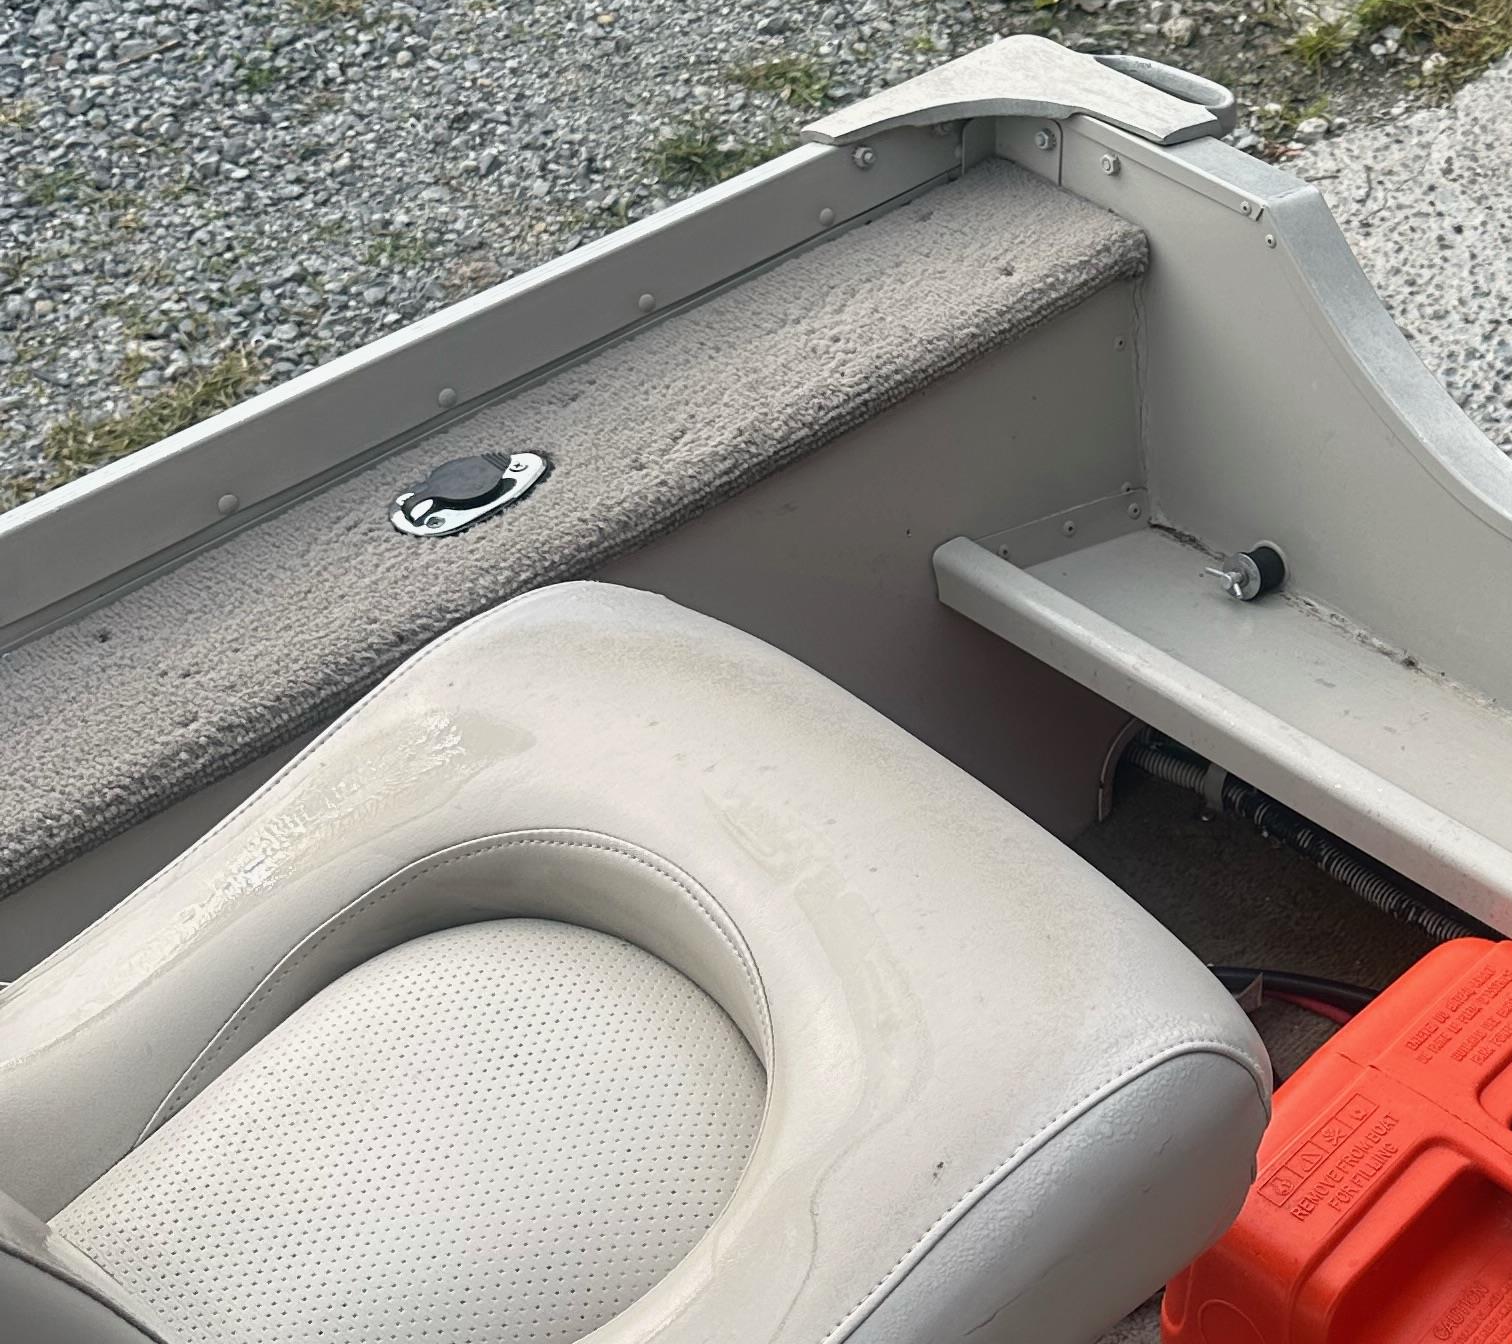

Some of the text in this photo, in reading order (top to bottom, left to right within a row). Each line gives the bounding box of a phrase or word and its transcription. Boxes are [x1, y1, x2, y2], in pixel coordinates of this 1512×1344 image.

[1289, 1111, 1400, 1223] REMOVE FROM BOAT
[1327, 1143, 1399, 1212] FOR FILLING
[1430, 1281, 1490, 1342] CAUTION
